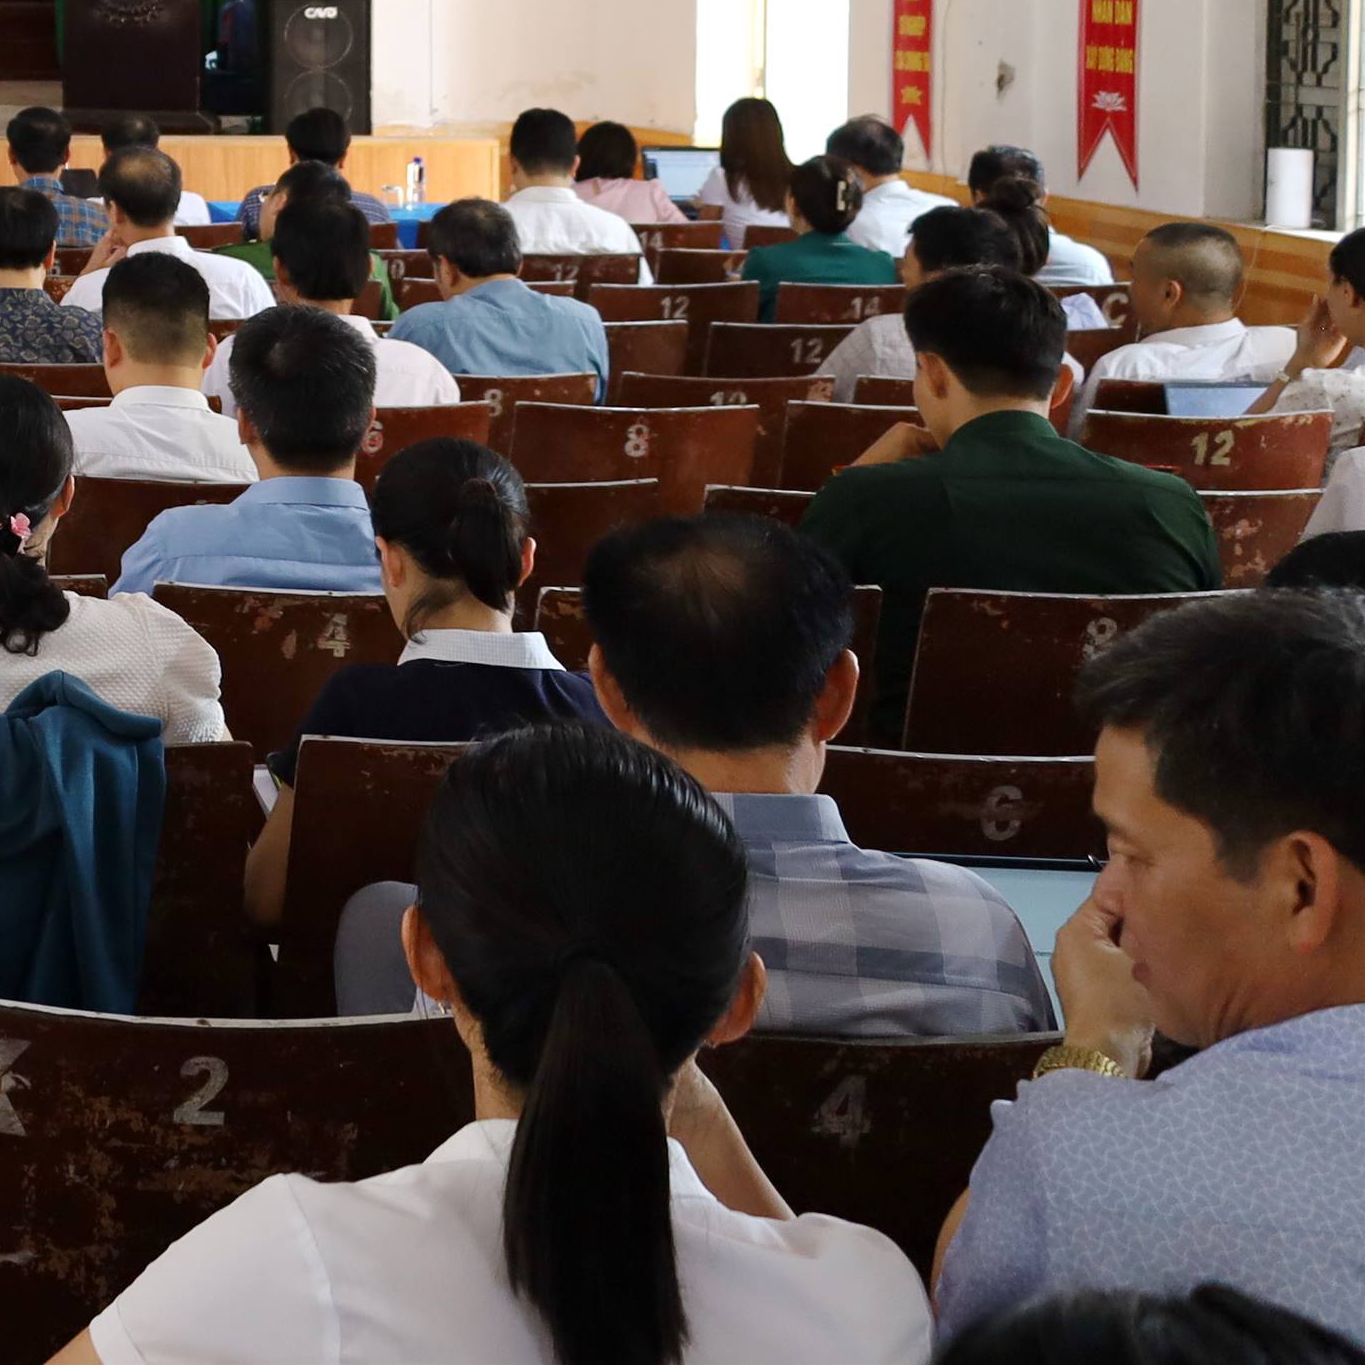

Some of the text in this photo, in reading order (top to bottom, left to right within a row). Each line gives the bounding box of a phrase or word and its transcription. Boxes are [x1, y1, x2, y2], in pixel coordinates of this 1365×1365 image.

[661, 297, 688, 320] 12
[625, 424, 648, 457] 8
[1192, 430, 1234, 466] 12
[173, 1056, 228, 1126] 2
